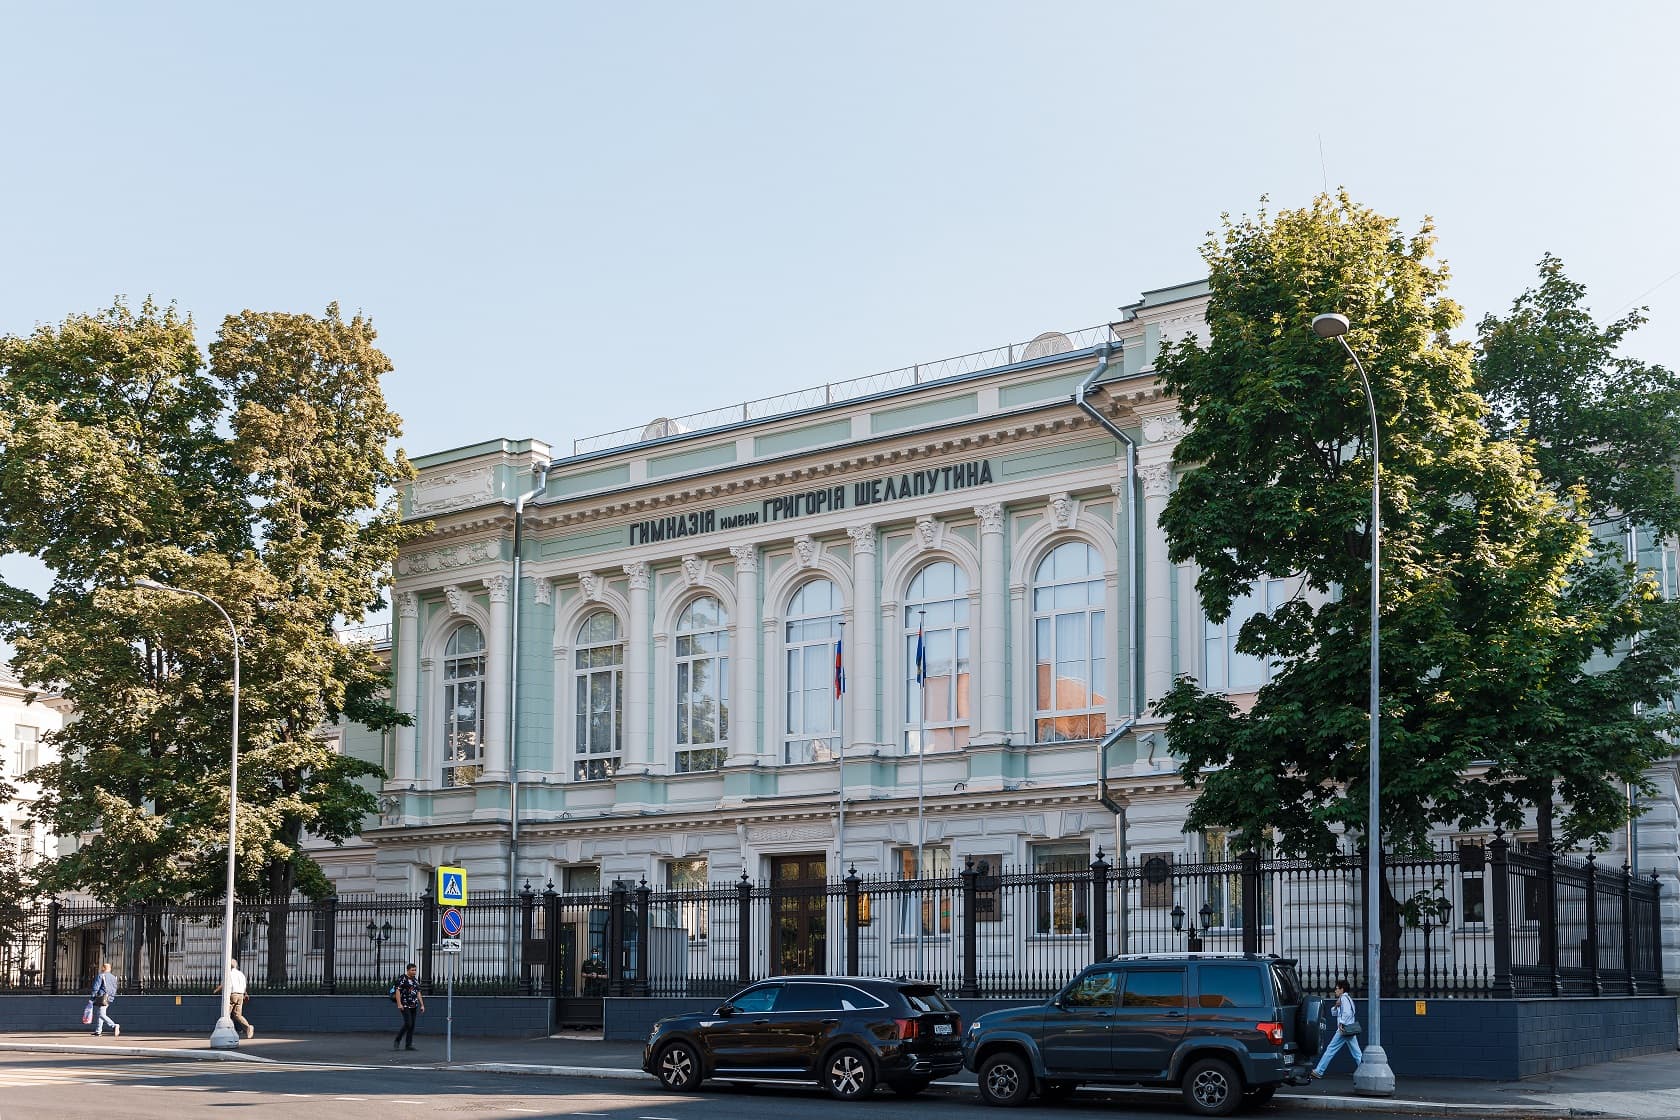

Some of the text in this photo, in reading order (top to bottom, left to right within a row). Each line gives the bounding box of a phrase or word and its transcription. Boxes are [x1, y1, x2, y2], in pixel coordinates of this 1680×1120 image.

[630, 459, 993, 546] ГИМНАЗІЯ имени ГРИГОРІЯ ШЕЛАПУТИНА
